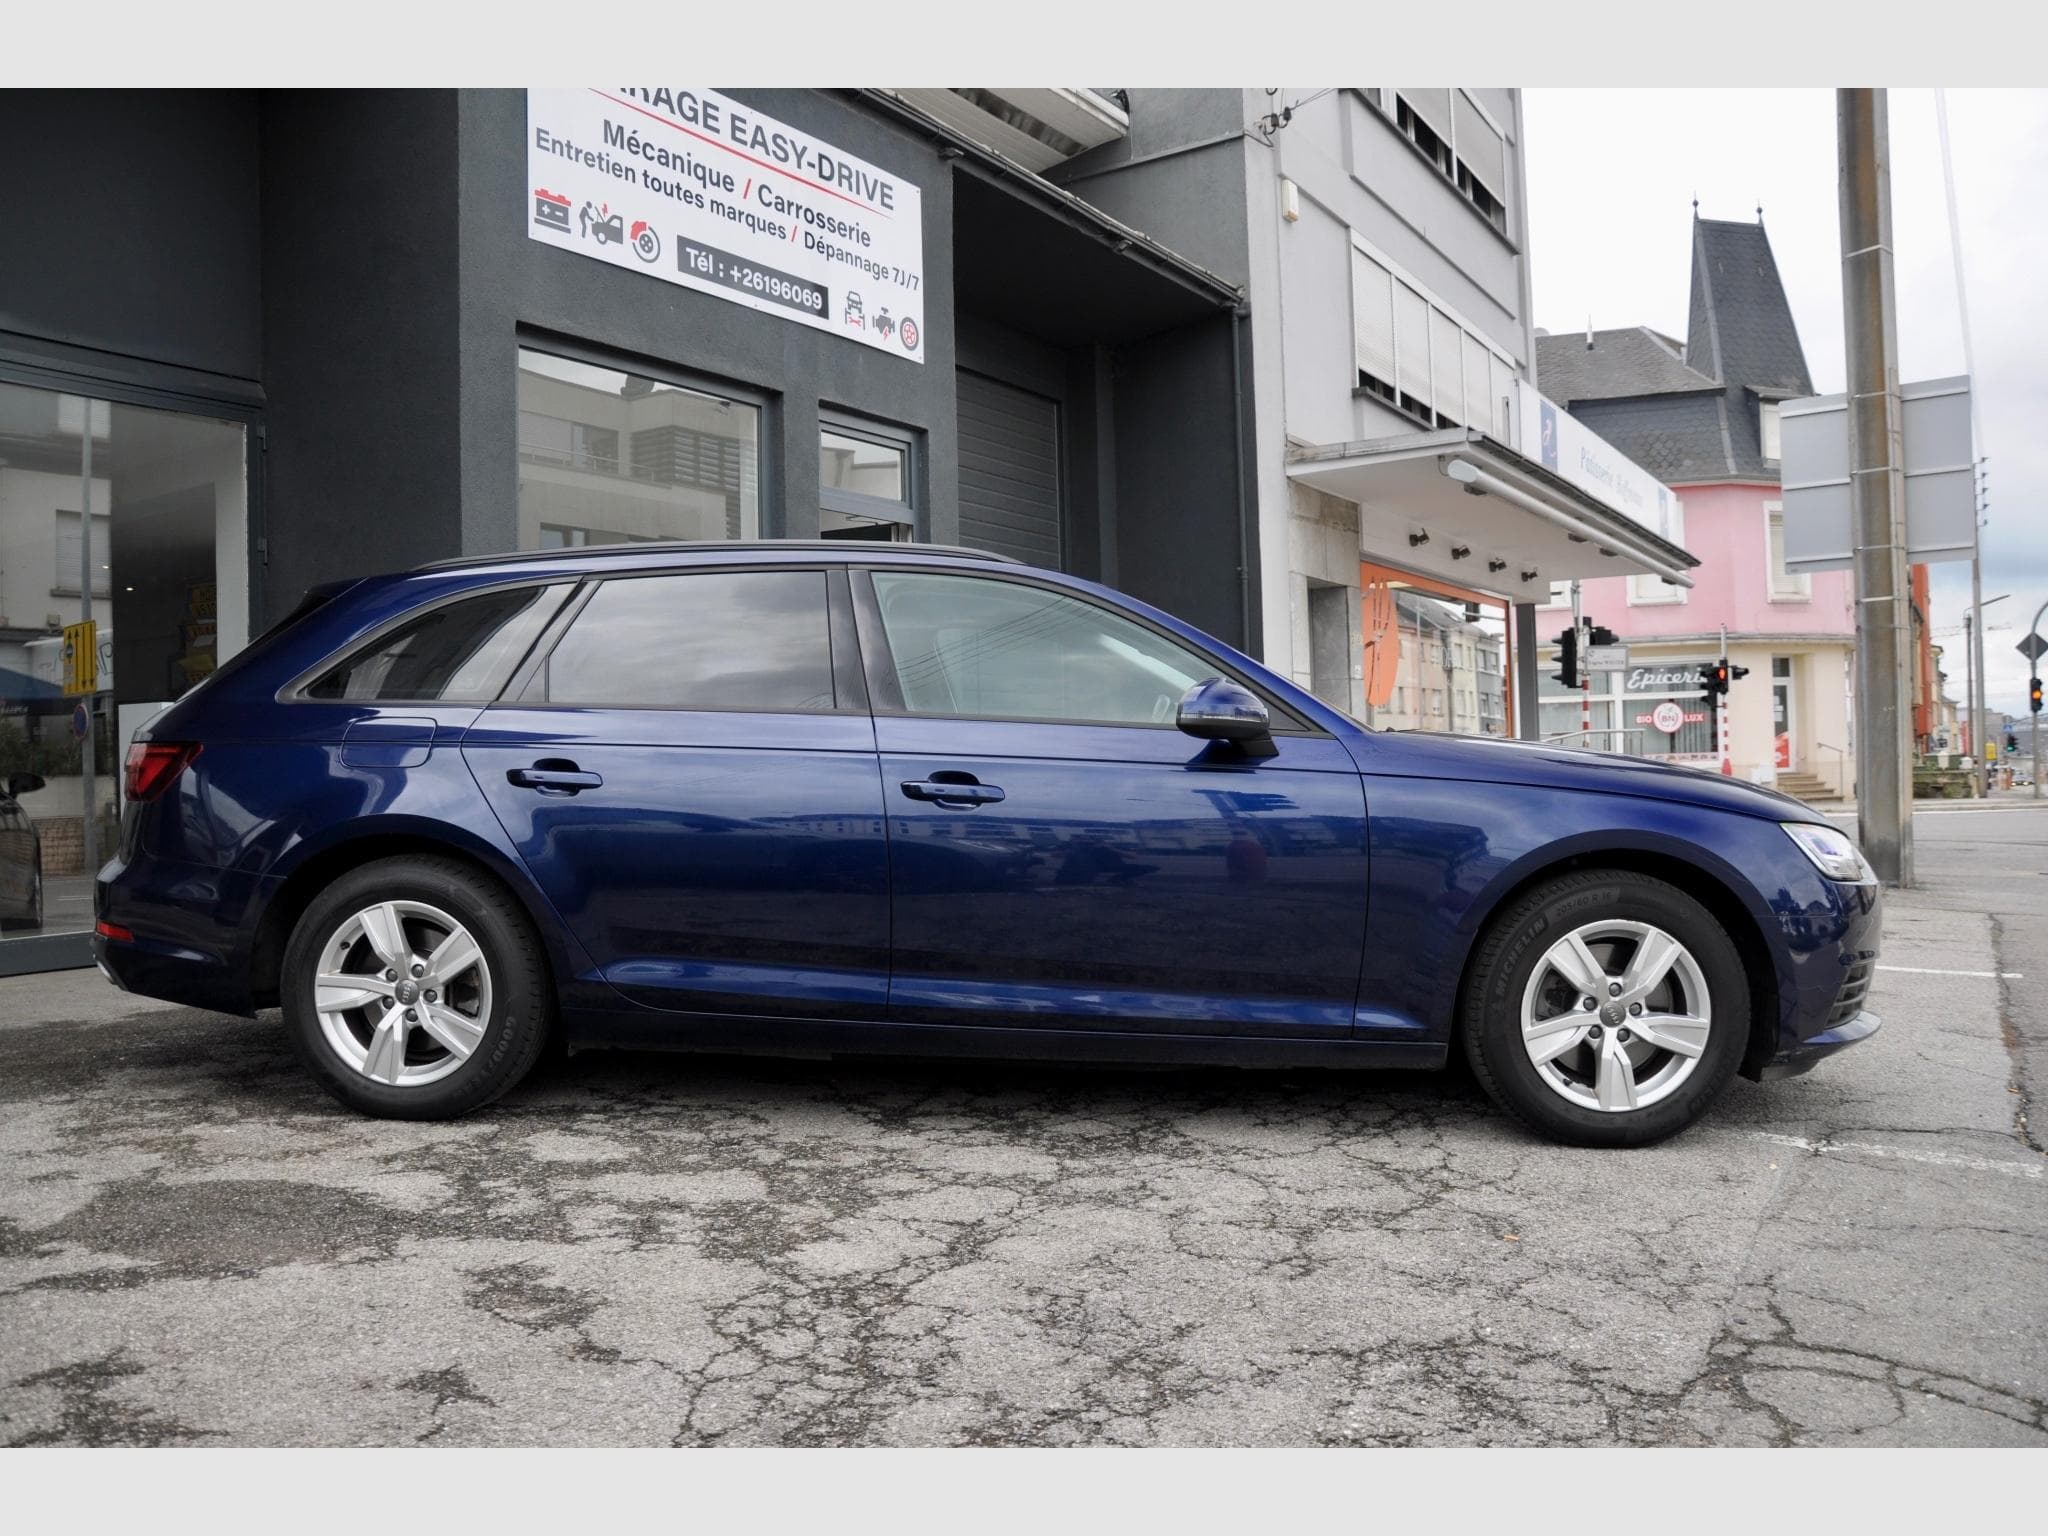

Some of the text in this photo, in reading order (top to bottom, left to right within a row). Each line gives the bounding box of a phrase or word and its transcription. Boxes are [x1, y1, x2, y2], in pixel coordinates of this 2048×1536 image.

[603, 119, 735, 192] Mécanique
[758, 184, 871, 248] Carrosserie
[620, 88, 894, 211] AGE EASY-DRIVE
[536, 127, 636, 184] Entretien
[642, 169, 705, 209] toutes
[710, 199, 787, 240] marques
[804, 231, 889, 281] Dépannage
[892, 267, 920, 291] 7J/7
[685, 246, 714, 274] Tél
[730, 265, 823, 310] +26196069
[1627, 667, 1708, 689] Epiceri
[1636, 715, 1653, 724] BIO
[1684, 713, 1704, 722] LUX
[1495, 918, 1546, 997] MICHELIN
